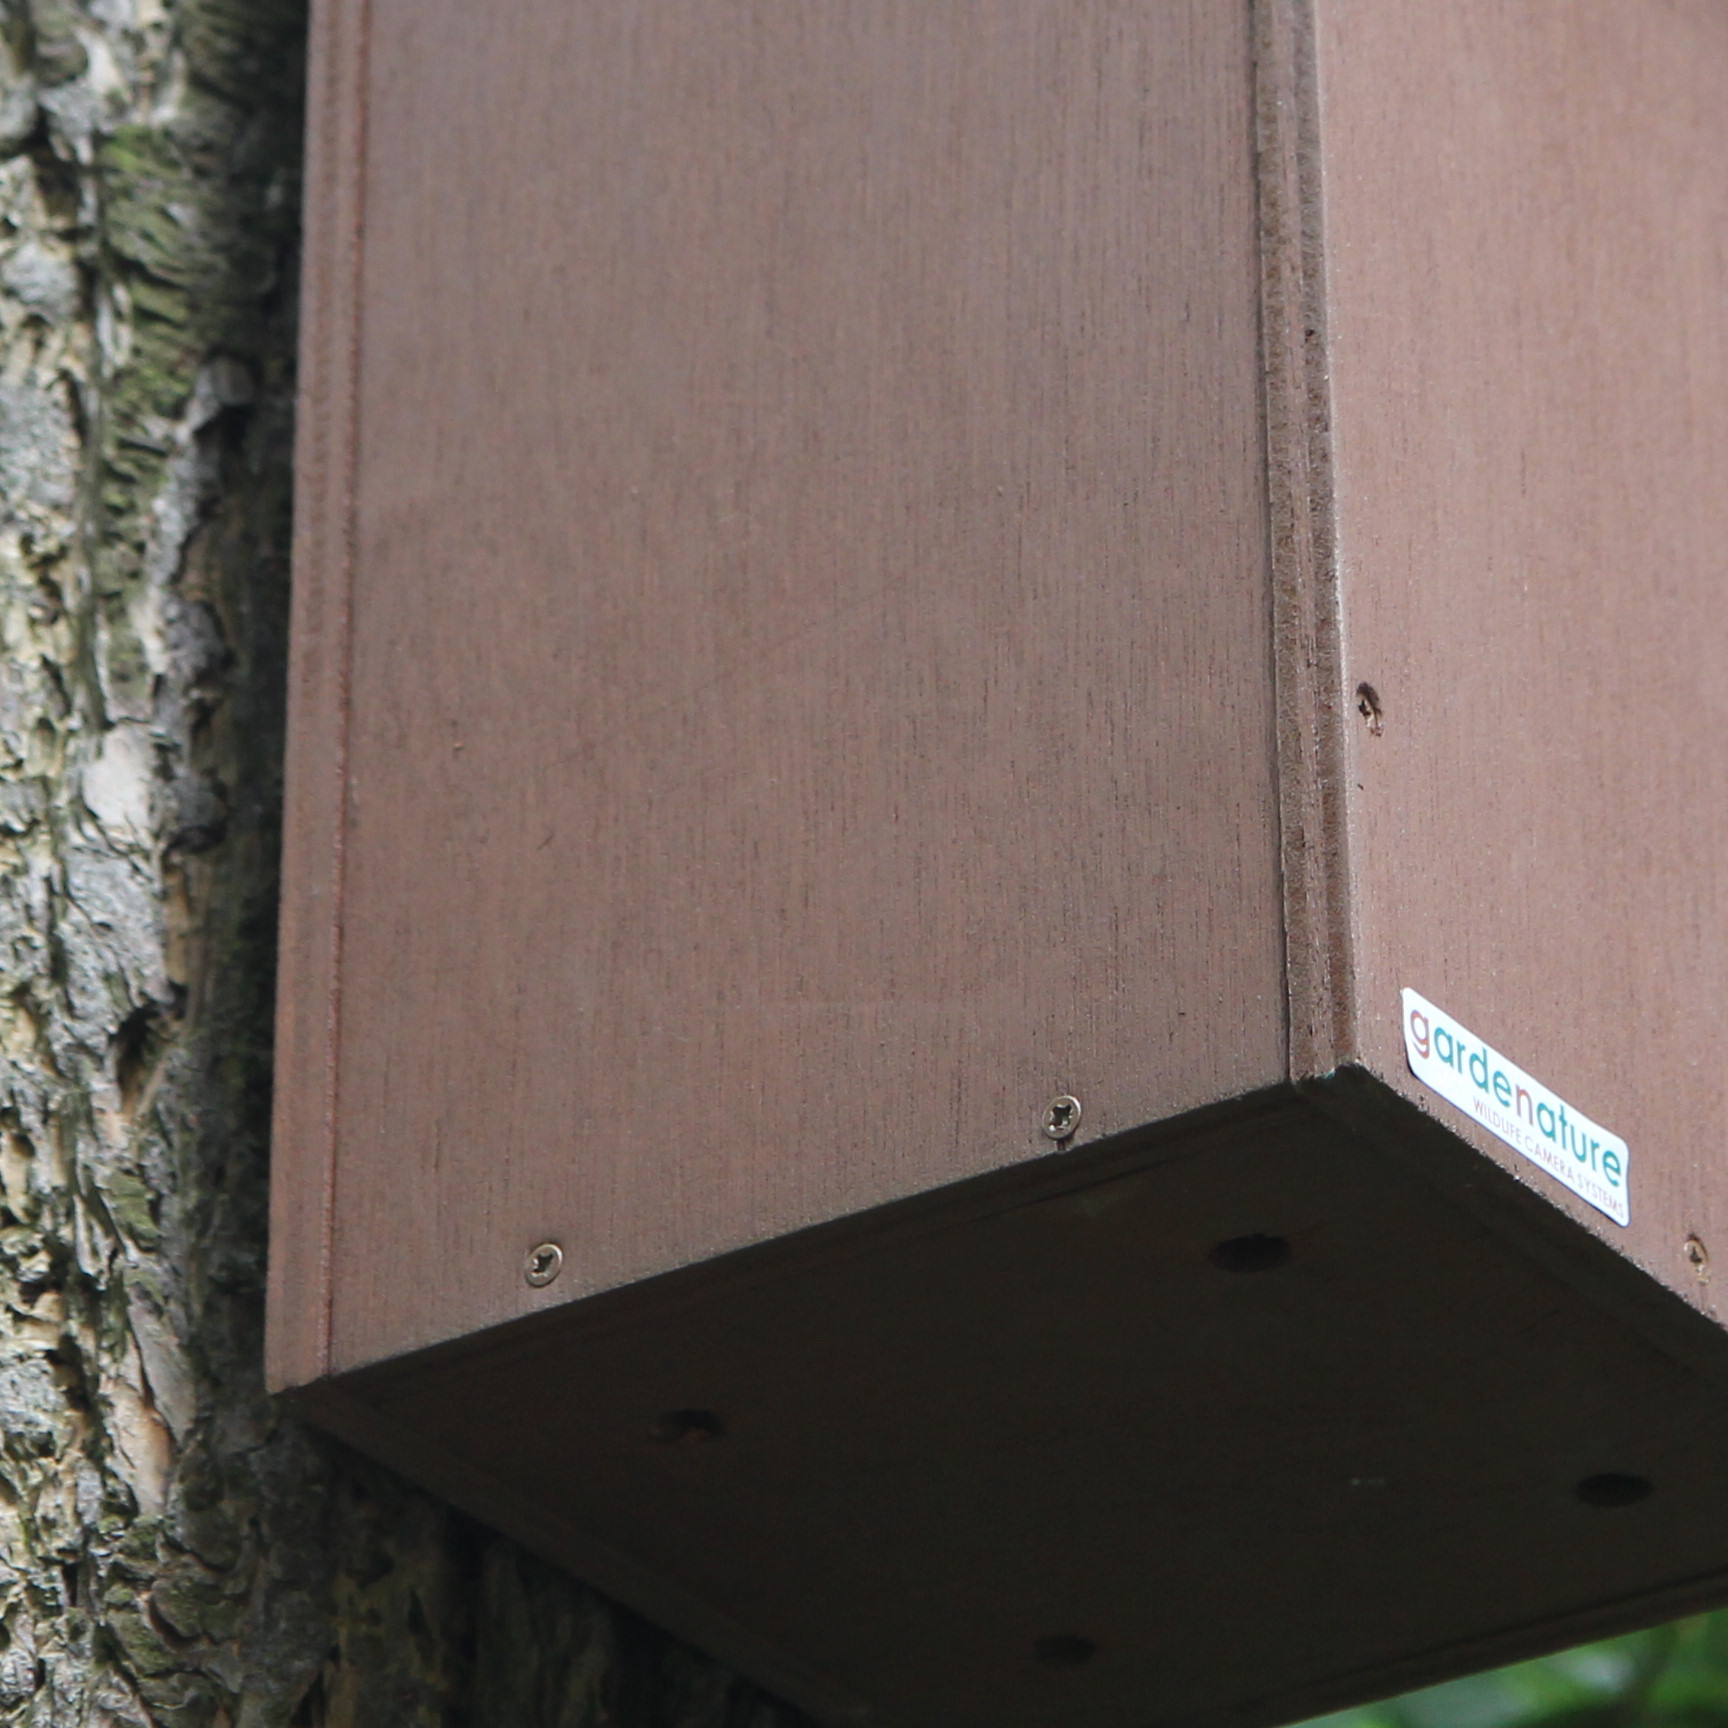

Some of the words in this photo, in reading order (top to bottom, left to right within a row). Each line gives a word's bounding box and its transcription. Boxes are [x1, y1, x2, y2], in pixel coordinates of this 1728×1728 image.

[1410, 1009, 1622, 1187] gardenature
[1473, 1096, 1522, 1145] WILDLIFE
[1524, 1135, 1575, 1182] CAMERA
[1577, 1173, 1625, 1219] SYSTEMS
